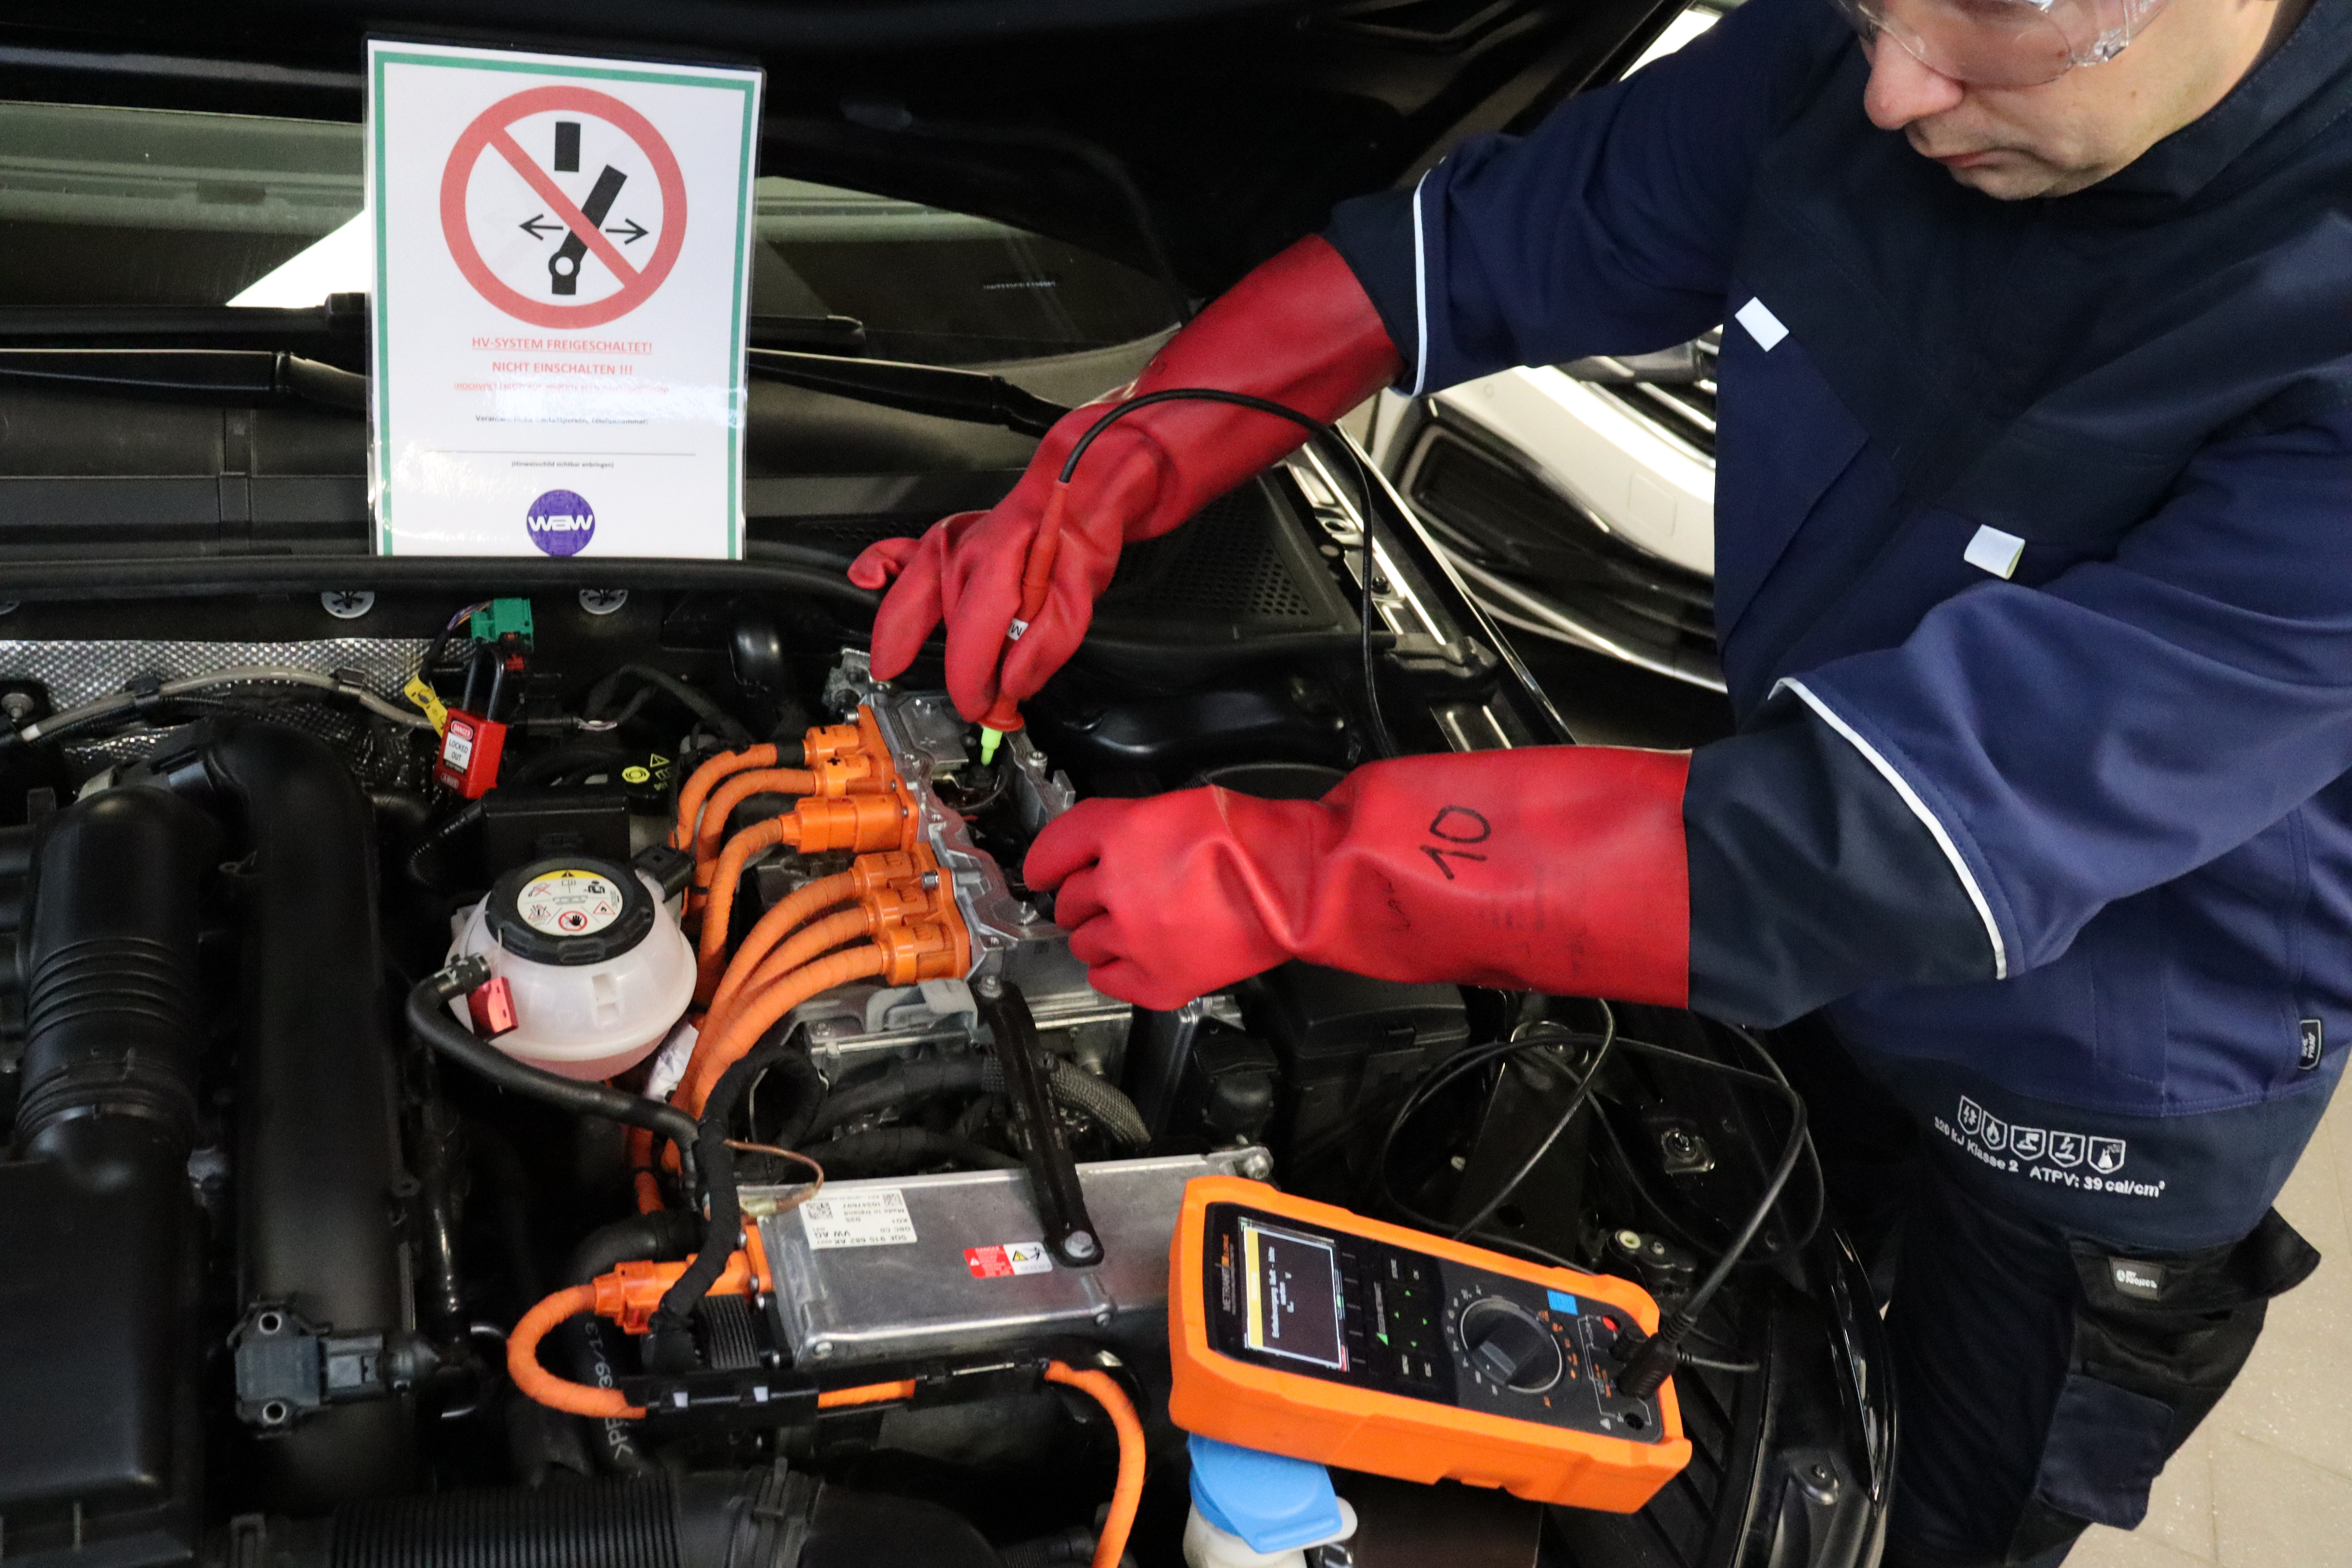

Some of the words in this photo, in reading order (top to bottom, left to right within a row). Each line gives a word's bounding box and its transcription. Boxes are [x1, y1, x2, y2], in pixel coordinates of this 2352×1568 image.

[472, 337, 543, 349] HV-SYSTEM
[547, 339, 653, 352] FREIGESCHALTET!
[492, 361, 529, 373] NICHT
[533, 363, 615, 375] EINSCHALTEN
[620, 365, 633, 375] !!!
[453, 723, 471, 737] DANGER
[449, 739, 468, 753] LOCKED
[451, 751, 462, 762] OUT
[1419, 805, 1491, 880] 10
[1951, 1128, 1965, 1145] kJ
[1967, 1139, 2006, 1171] Klasse
[2008, 1160, 2019, 1172] 2
[2029, 1166, 2080, 1187] ATPV:
[2083, 1176, 2103, 1191] 39
